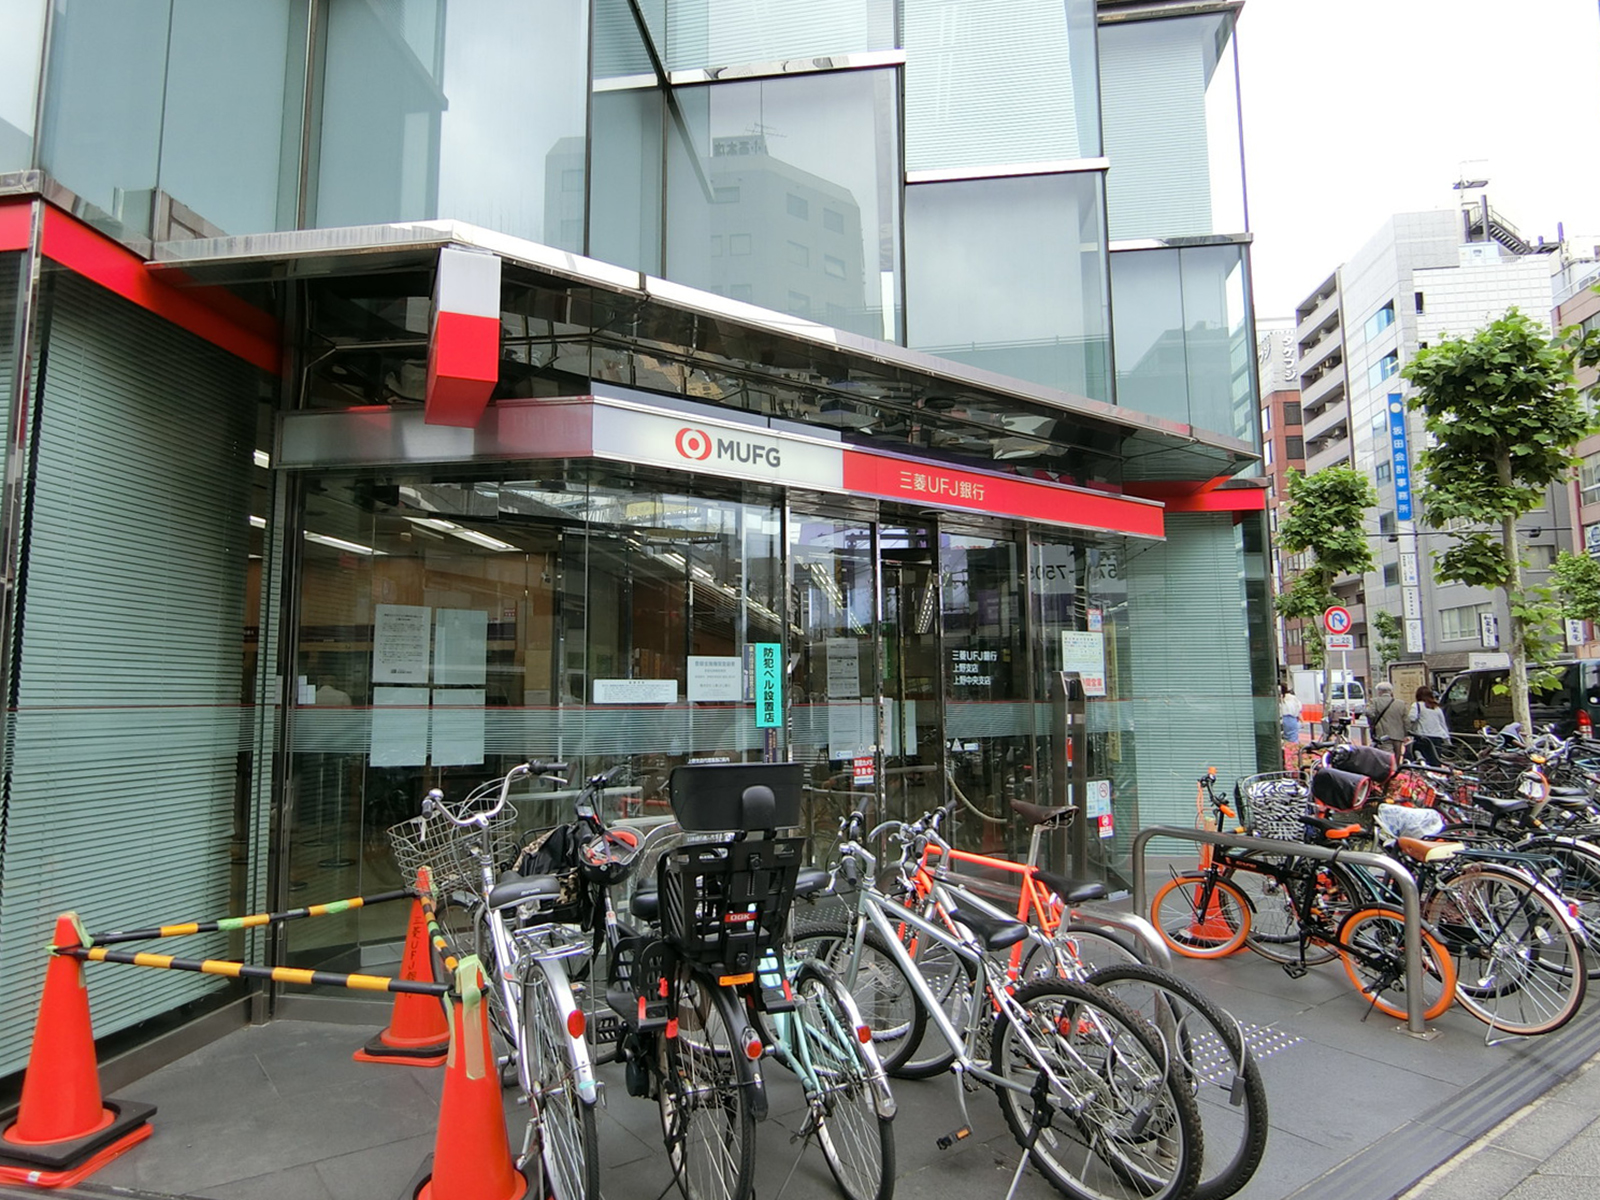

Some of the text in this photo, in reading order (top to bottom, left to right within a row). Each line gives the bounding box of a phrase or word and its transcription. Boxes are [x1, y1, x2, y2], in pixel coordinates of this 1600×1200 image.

[1282, 336, 1298, 381] タケフジ
[717, 438, 781, 468] MUFG
[900, 471, 985, 501] 三菱UFJ銀行
[952, 650, 997, 661] 三菱UFJ銀行
[763, 647, 775, 723] 防犯ベル設置店
[730, 913, 750, 922] OGK
